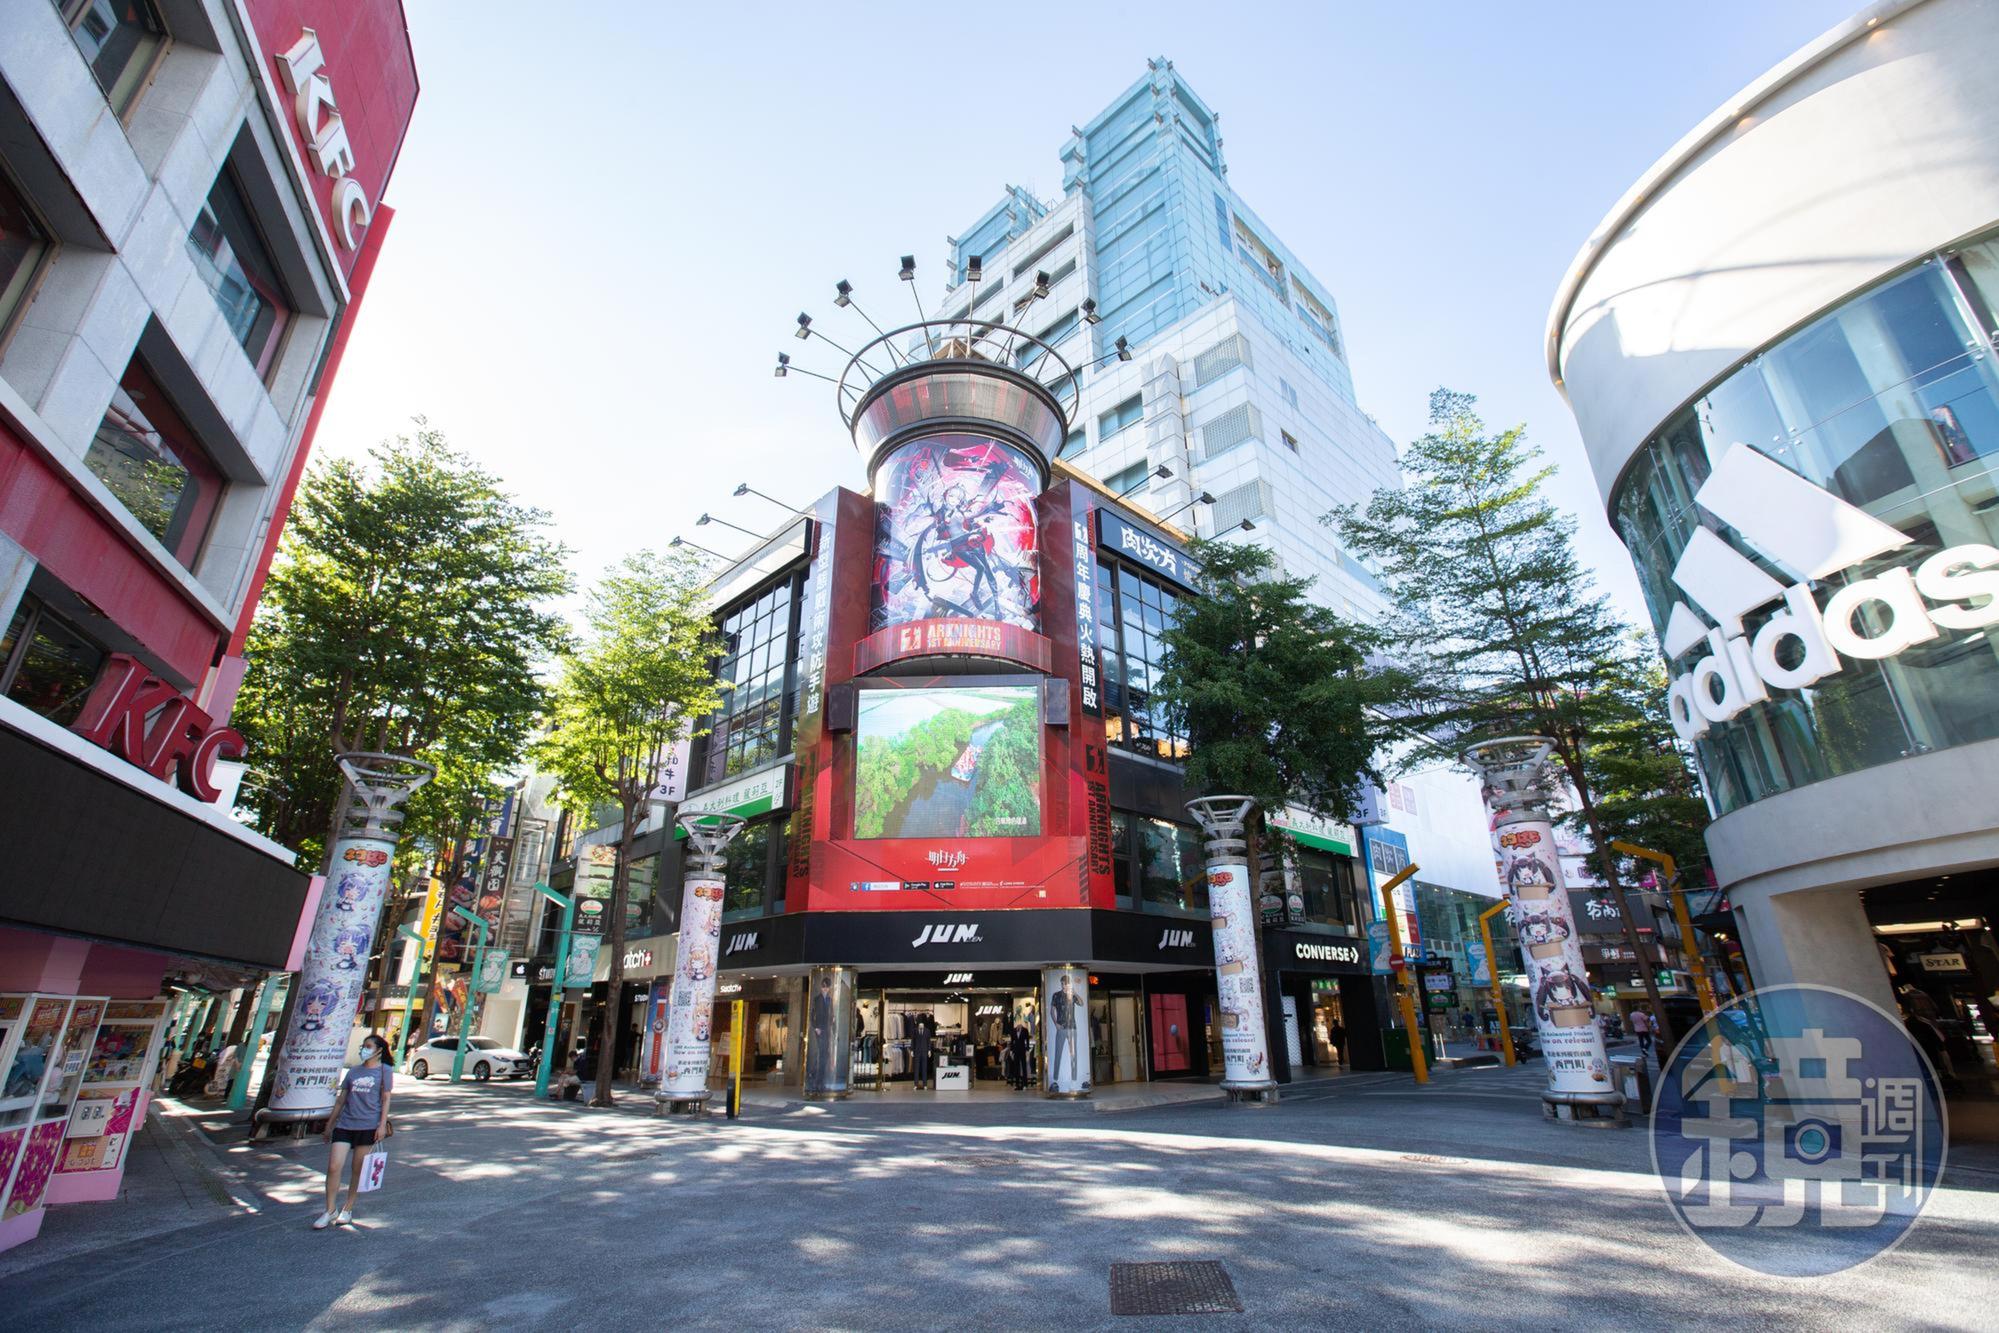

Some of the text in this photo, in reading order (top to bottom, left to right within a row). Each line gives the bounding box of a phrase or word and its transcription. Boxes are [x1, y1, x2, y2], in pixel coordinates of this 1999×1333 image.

[275, 27, 371, 252] KFC
[1120, 526, 1177, 577] 肉次方
[927, 624, 1001, 642] ARKNIGHTS
[1667, 543, 1999, 742] adidas
[943, 637, 1001, 651] ANNIVERSARY
[72, 652, 248, 803] KFC
[660, 785, 675, 795] 3F
[1356, 808, 1368, 818] 3F
[1088, 799, 1100, 874] ANNIVERSARY
[1096, 781, 1110, 875] ARKNIGHTS
[726, 933, 757, 956] JUN
[912, 924, 978, 948] JUN
[1159, 929, 1194, 950] JUN
[623, 950, 645, 969] atch
[1295, 943, 1351, 962] CONVERSE
[1925, 958, 1960, 968] STAR
[943, 973, 973, 985] JUN
[975, 1005, 1003, 1017] JUN
